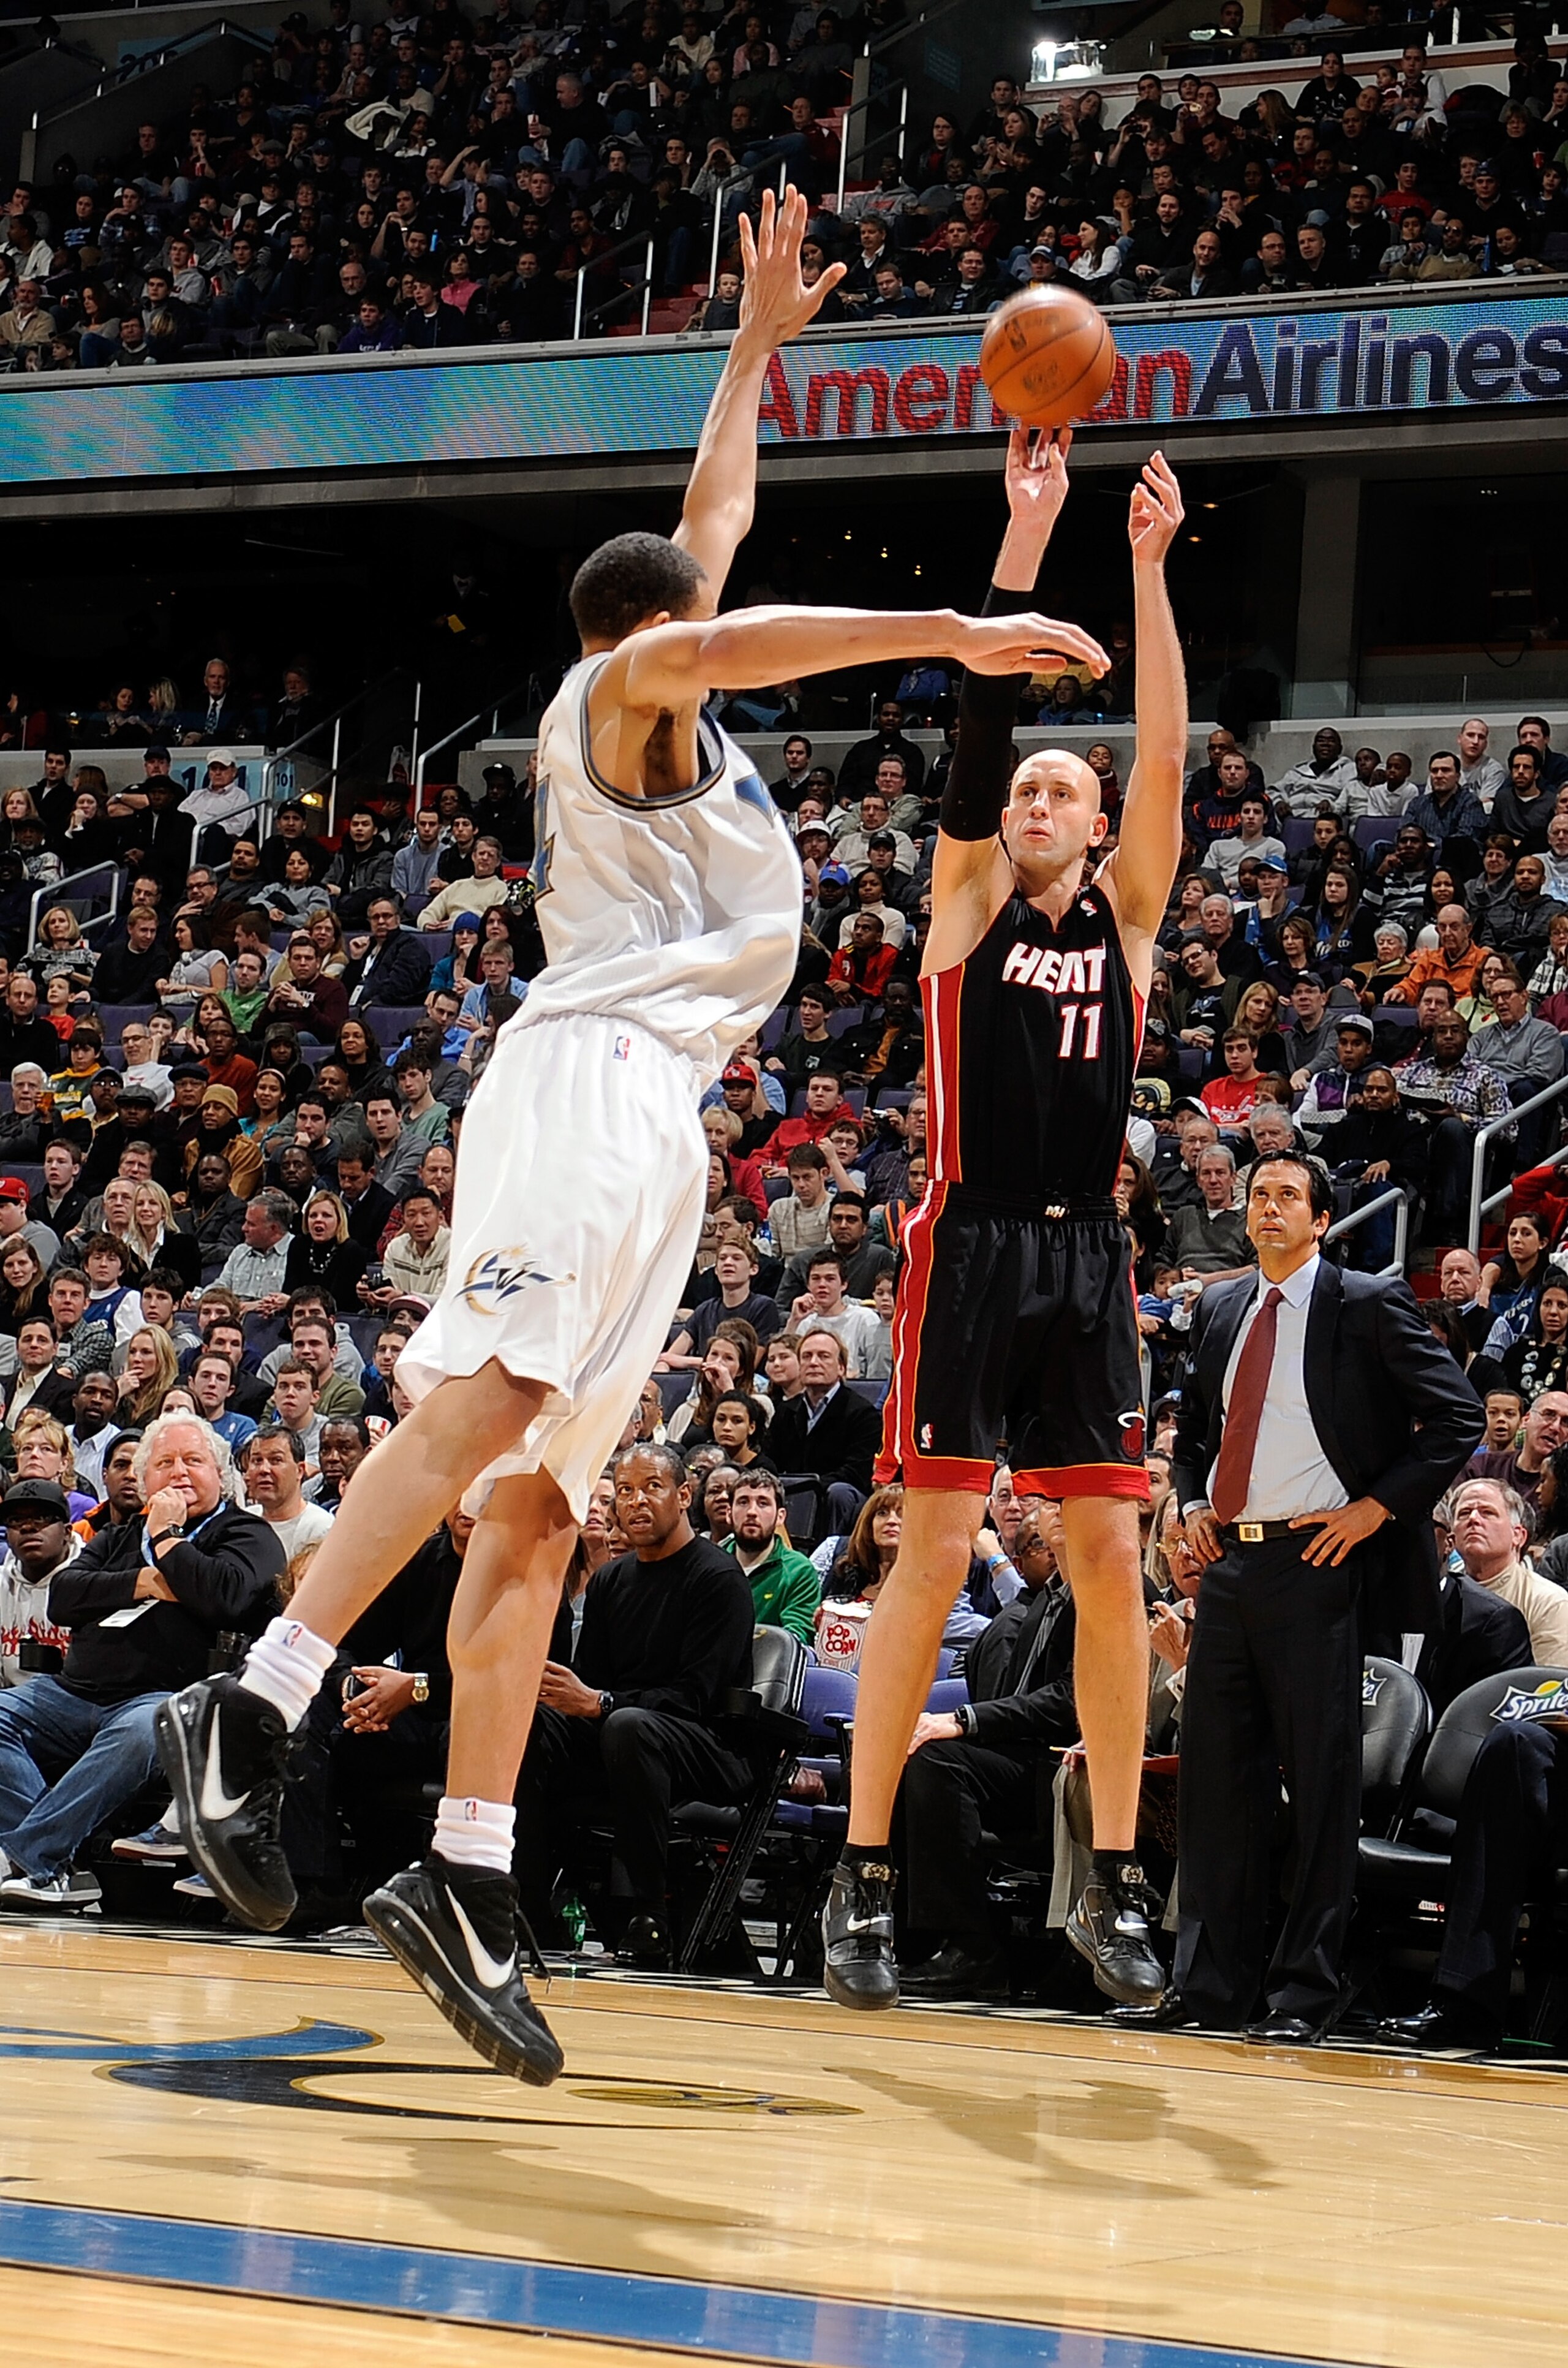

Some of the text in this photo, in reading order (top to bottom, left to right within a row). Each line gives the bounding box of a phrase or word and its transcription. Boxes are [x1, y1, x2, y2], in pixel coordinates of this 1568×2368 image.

[1193, 315, 1568, 416] Airlines
[277, 772, 293, 788] 101
[1001, 938, 1107, 994] HEAT
[1057, 1002, 1104, 1060] 11
[827, 1624, 850, 1640] POP
[825, 1639, 856, 1655] CORN
[1500, 1694, 1568, 1721] Sprite
